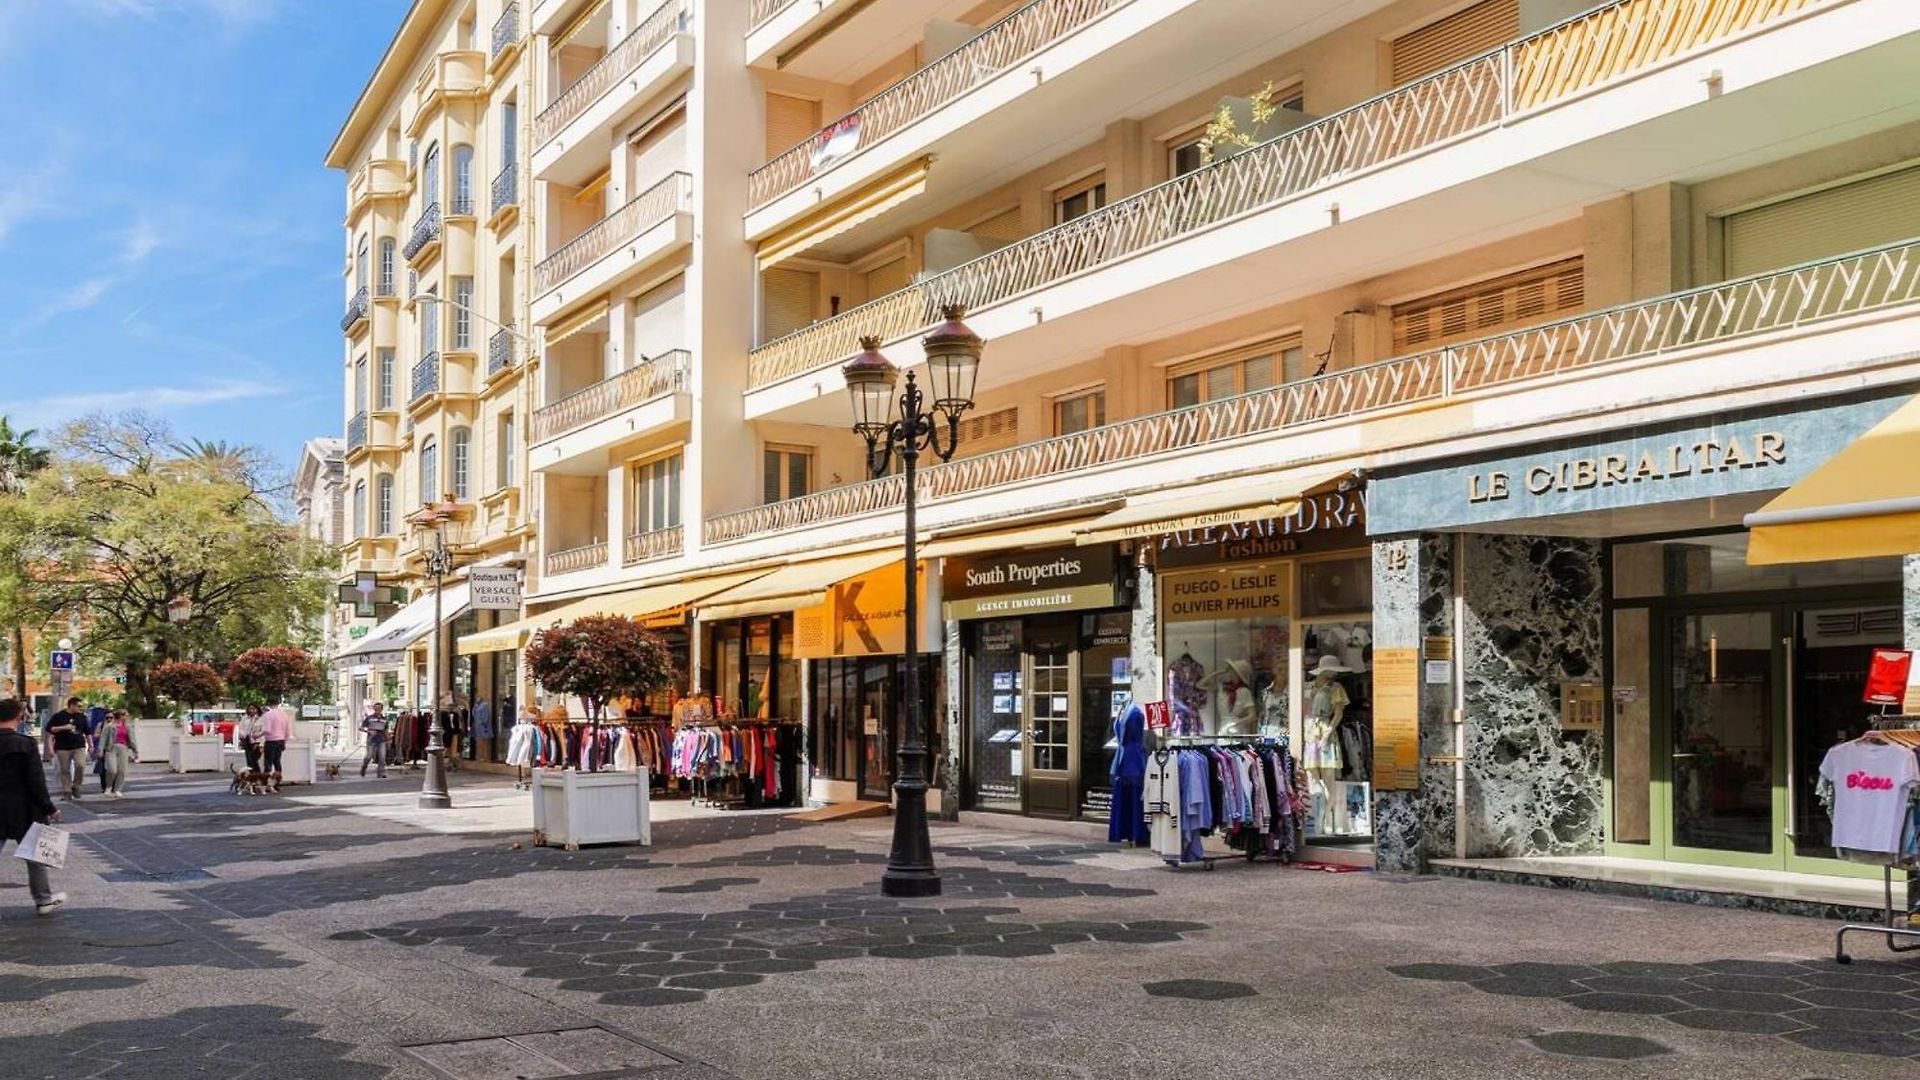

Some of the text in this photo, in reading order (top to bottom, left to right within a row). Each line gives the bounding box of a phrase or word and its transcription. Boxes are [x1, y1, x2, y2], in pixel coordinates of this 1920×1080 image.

[1468, 432, 1787, 503] LE GIBRALTAR
[966, 557, 1081, 587] South Properties
[474, 586, 516, 595] VERSACE
[1174, 580, 1220, 596] FUEGO
[1232, 574, 1278, 590] LESLIE
[480, 596, 511, 604] GUESS
[976, 593, 1073, 612] AGENCE IMMOBILIÈRE
[1171, 594, 1280, 615] OLIVIER PHILIPS
